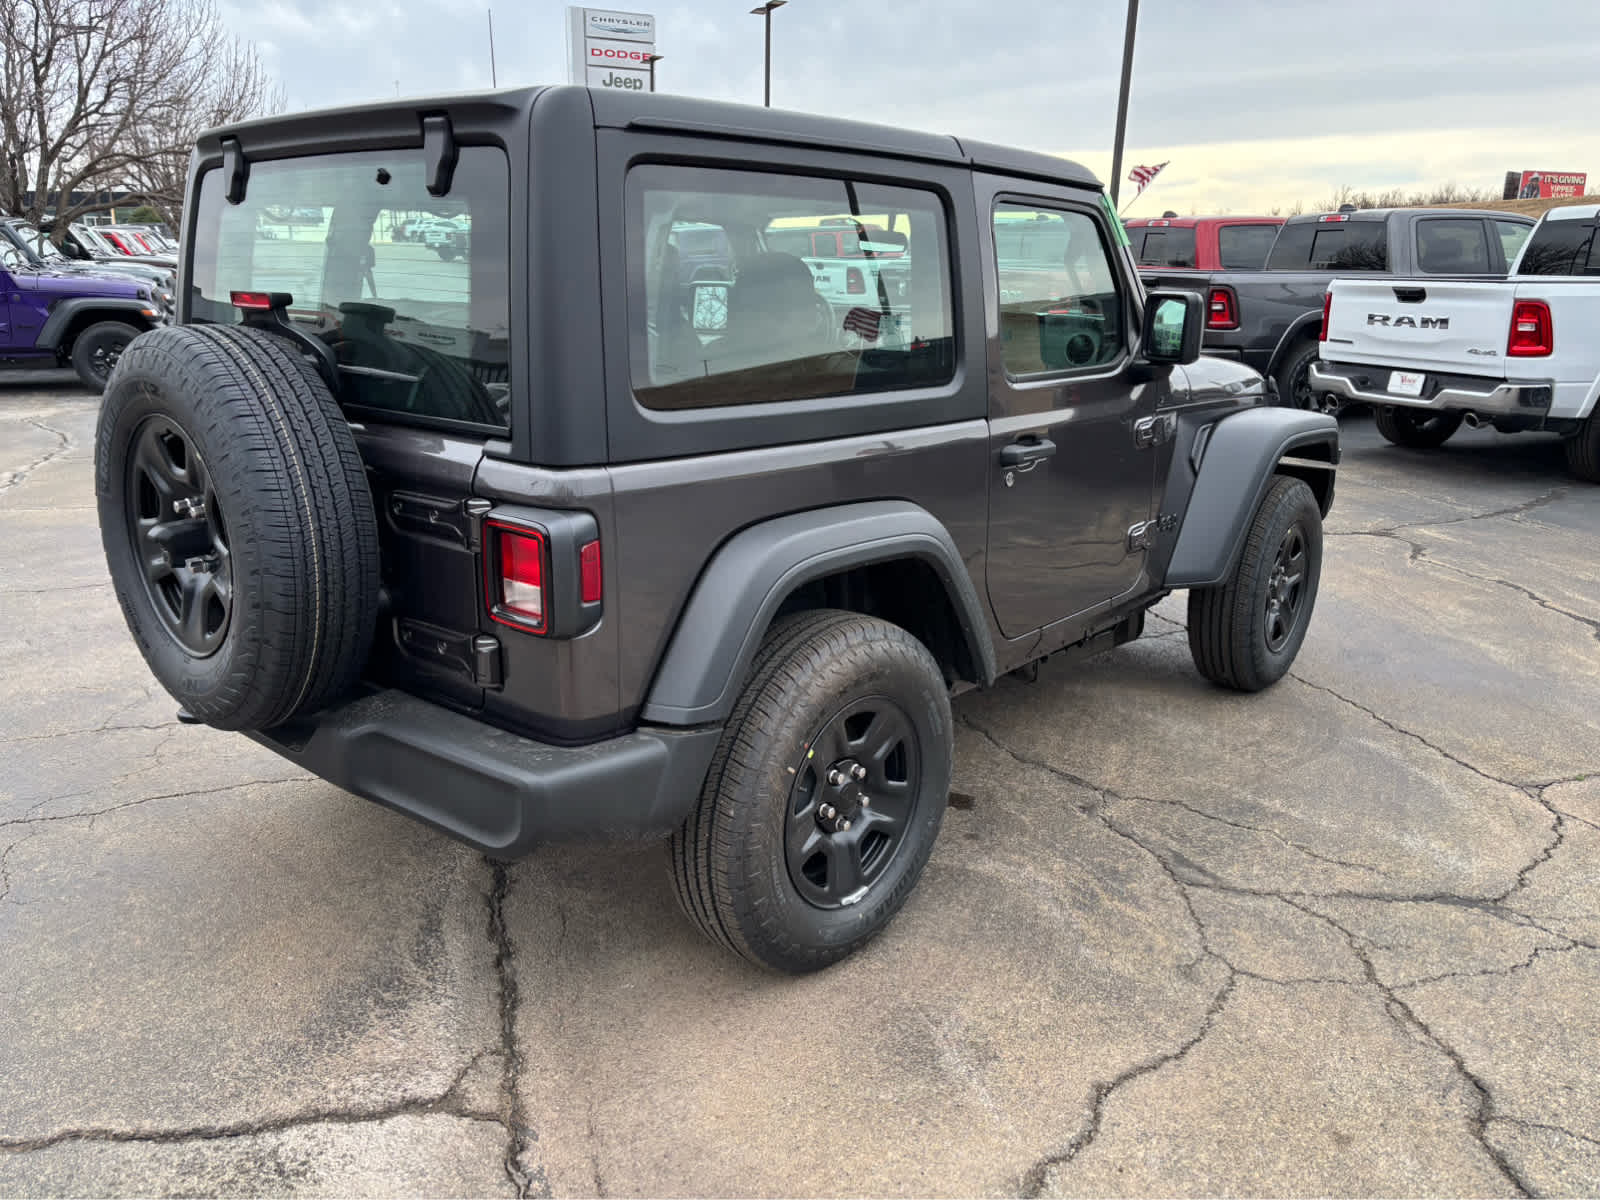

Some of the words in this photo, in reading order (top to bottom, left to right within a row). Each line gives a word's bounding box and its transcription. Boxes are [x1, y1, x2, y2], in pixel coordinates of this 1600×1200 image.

[591, 16, 650, 27] CHRYSLER
[591, 48, 653, 62] DODGE
[602, 72, 643, 90] Jeep
[1367, 313, 1449, 330] RAM
